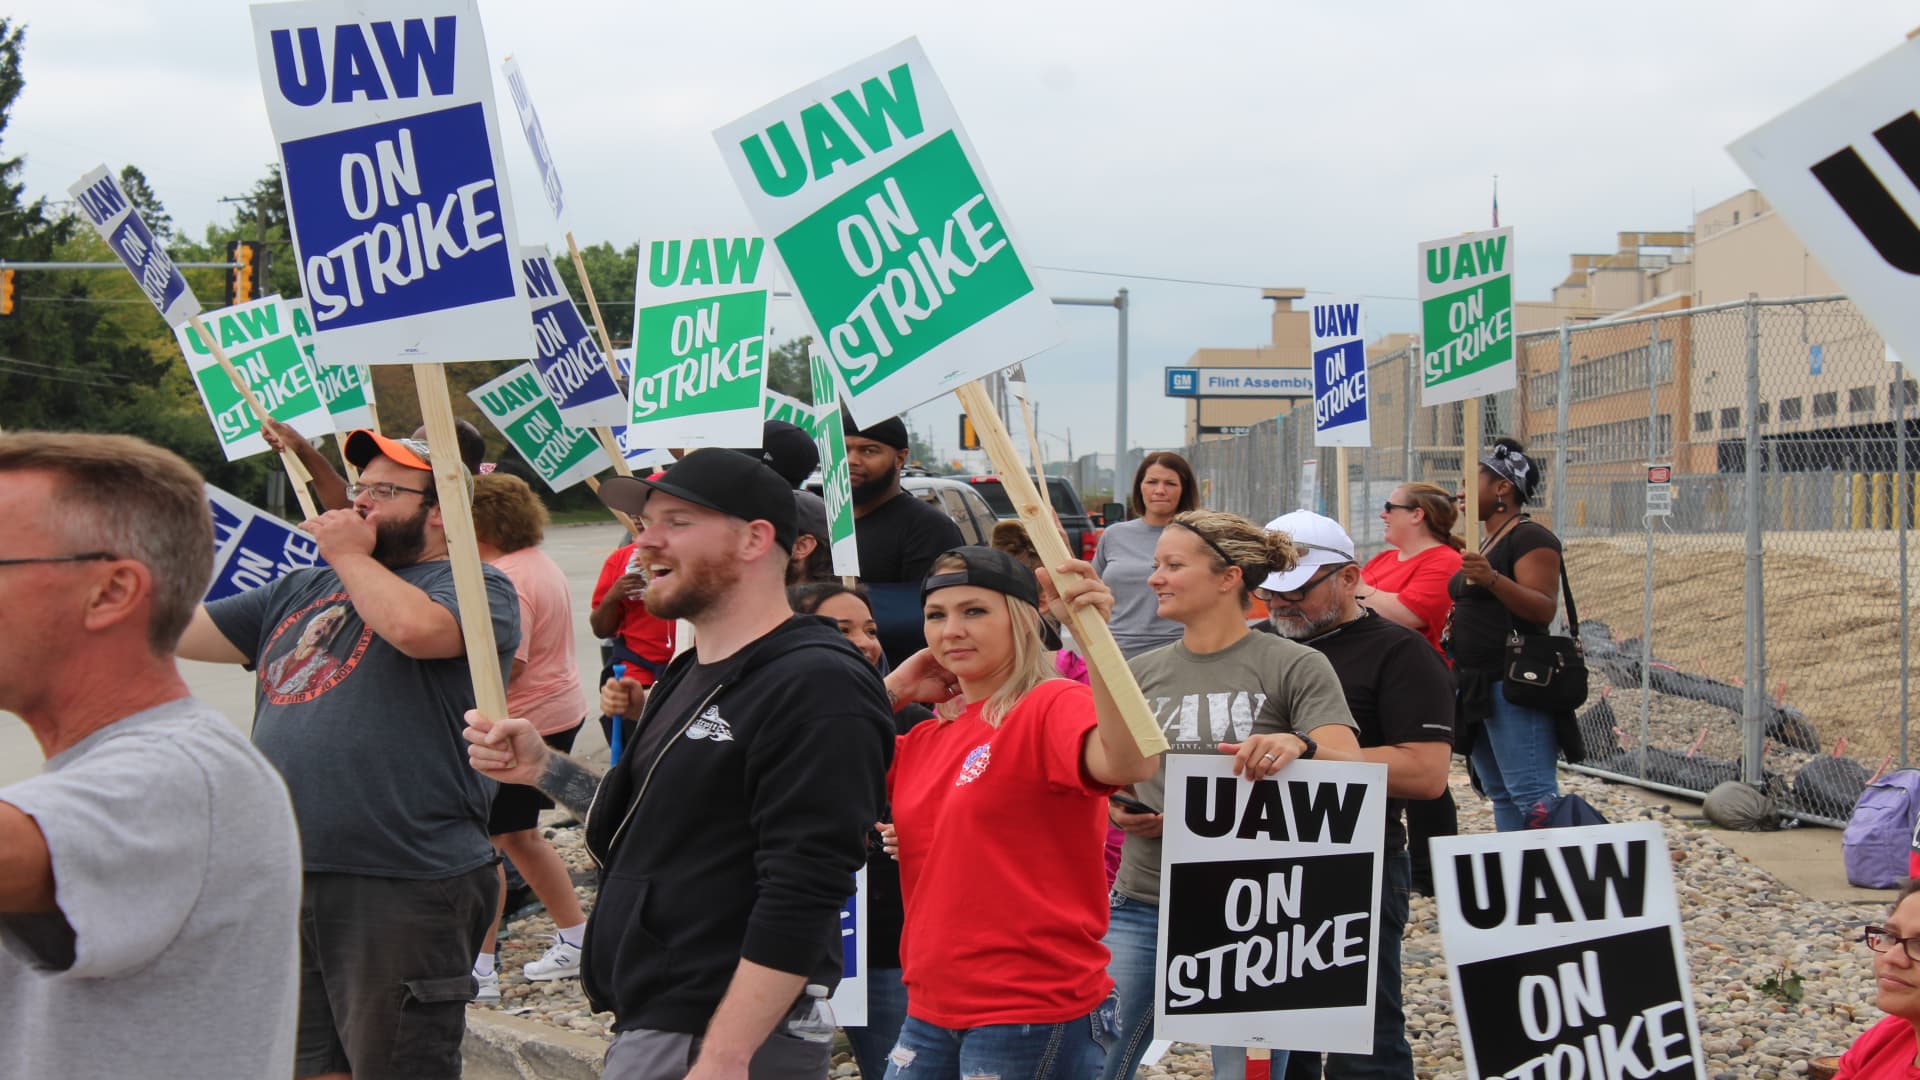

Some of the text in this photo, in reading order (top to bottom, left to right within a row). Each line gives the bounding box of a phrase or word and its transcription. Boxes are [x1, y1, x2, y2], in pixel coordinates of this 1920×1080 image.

[271, 16, 456, 107] UAW
[740, 63, 924, 198] UAW
[77, 175, 127, 226] UAW
[341, 128, 421, 220] ON
[121, 224, 147, 267] ON
[307, 179, 503, 321] STRIKE
[837, 177, 919, 277] ON
[1427, 235, 1507, 284] UAW
[143, 238, 172, 311] STRIKE
[649, 237, 764, 287] UAW
[829, 193, 1007, 386] STRIKE
[185, 303, 280, 355] UAW
[535, 311, 568, 357] ON
[671, 302, 720, 356] ON
[1314, 303, 1359, 338] UAW
[1449, 288, 1483, 334] ON
[542, 336, 604, 406] STRIKE
[634, 336, 763, 418] STRIKE
[1325, 347, 1346, 386] ON
[1425, 307, 1511, 384] STRIKE
[217, 363, 312, 441] STRIKE
[481, 371, 543, 418] UAW
[1173, 374, 1313, 391] GM Flint Assembly
[1316, 371, 1366, 428] STRIKE
[523, 410, 553, 443] ON
[231, 547, 274, 592] ON
[1185, 775, 1368, 844] UAW
[1225, 865, 1303, 932] ON
[1454, 840, 1648, 930] UAW
[1168, 912, 1369, 1008] STRIKE
[1518, 950, 1606, 1041] ON
